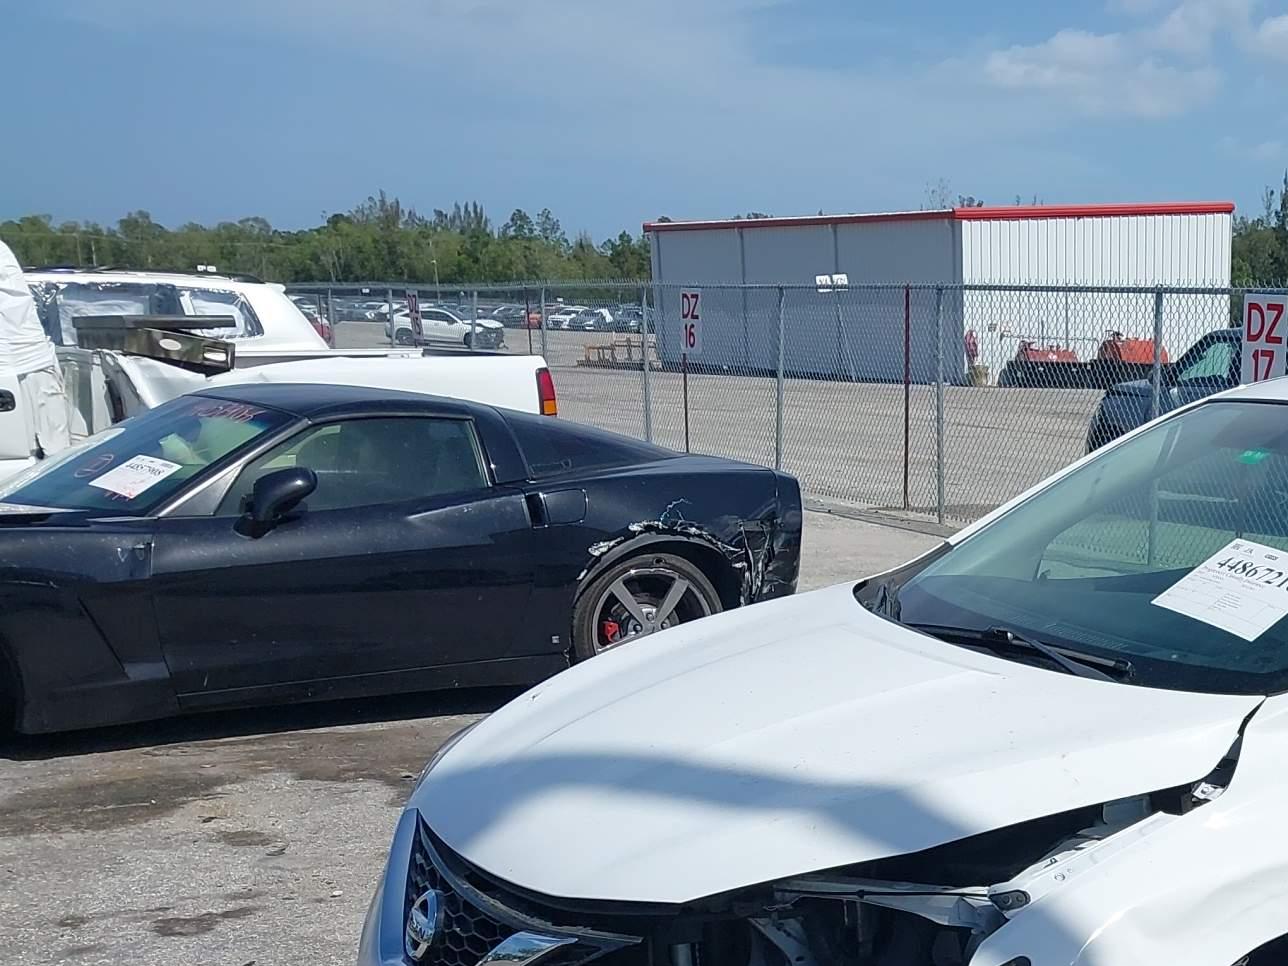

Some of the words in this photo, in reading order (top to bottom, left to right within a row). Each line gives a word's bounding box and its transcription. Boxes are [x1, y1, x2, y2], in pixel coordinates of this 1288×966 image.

[682, 293, 699, 319] DZ
[685, 323, 695, 348] 16
[1247, 303, 1284, 344] DZ
[1252, 349, 1275, 382] 17
